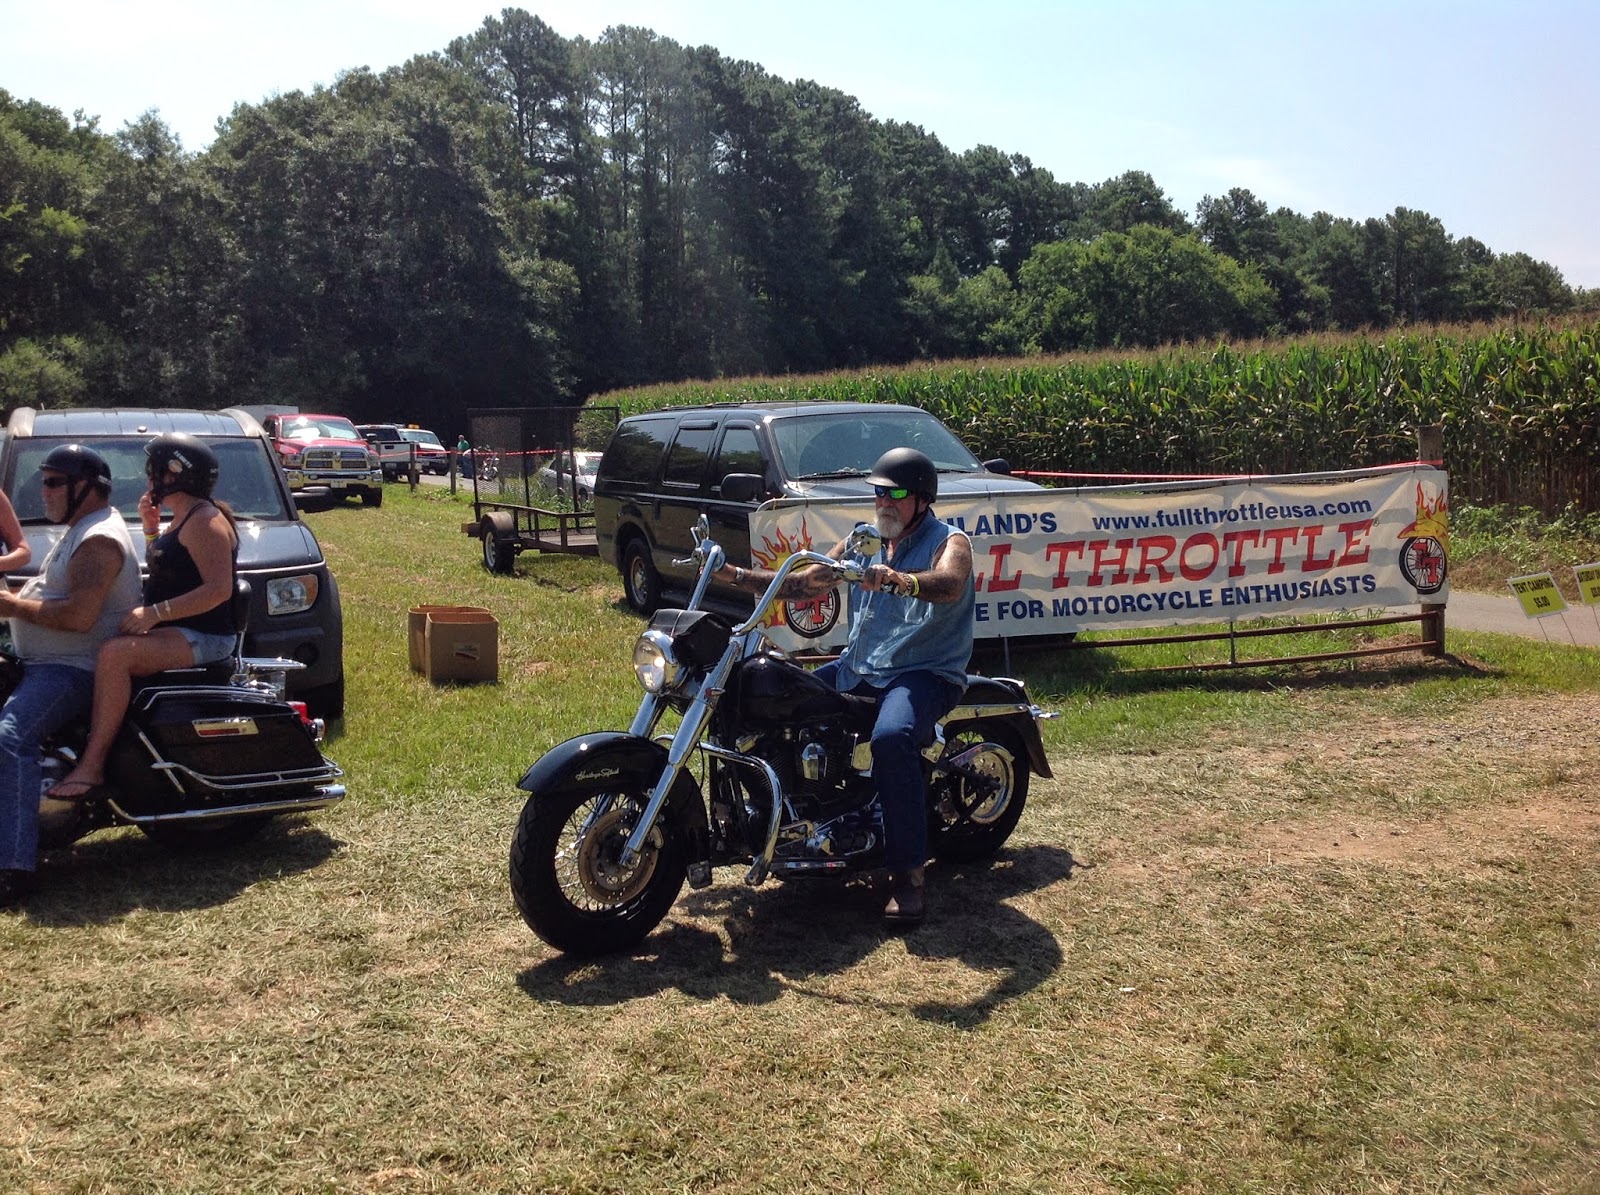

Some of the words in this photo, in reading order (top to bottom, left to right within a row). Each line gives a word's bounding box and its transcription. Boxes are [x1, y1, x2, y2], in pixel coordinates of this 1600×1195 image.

[1091, 500, 1372, 530] www.fullthrottleusa.com
[1045, 519, 1374, 589] THROTTLE
[997, 600, 1044, 620] FOR
[1052, 589, 1213, 618] MOTORCYCLE
[1220, 574, 1377, 606] ENTHUSIASTS
